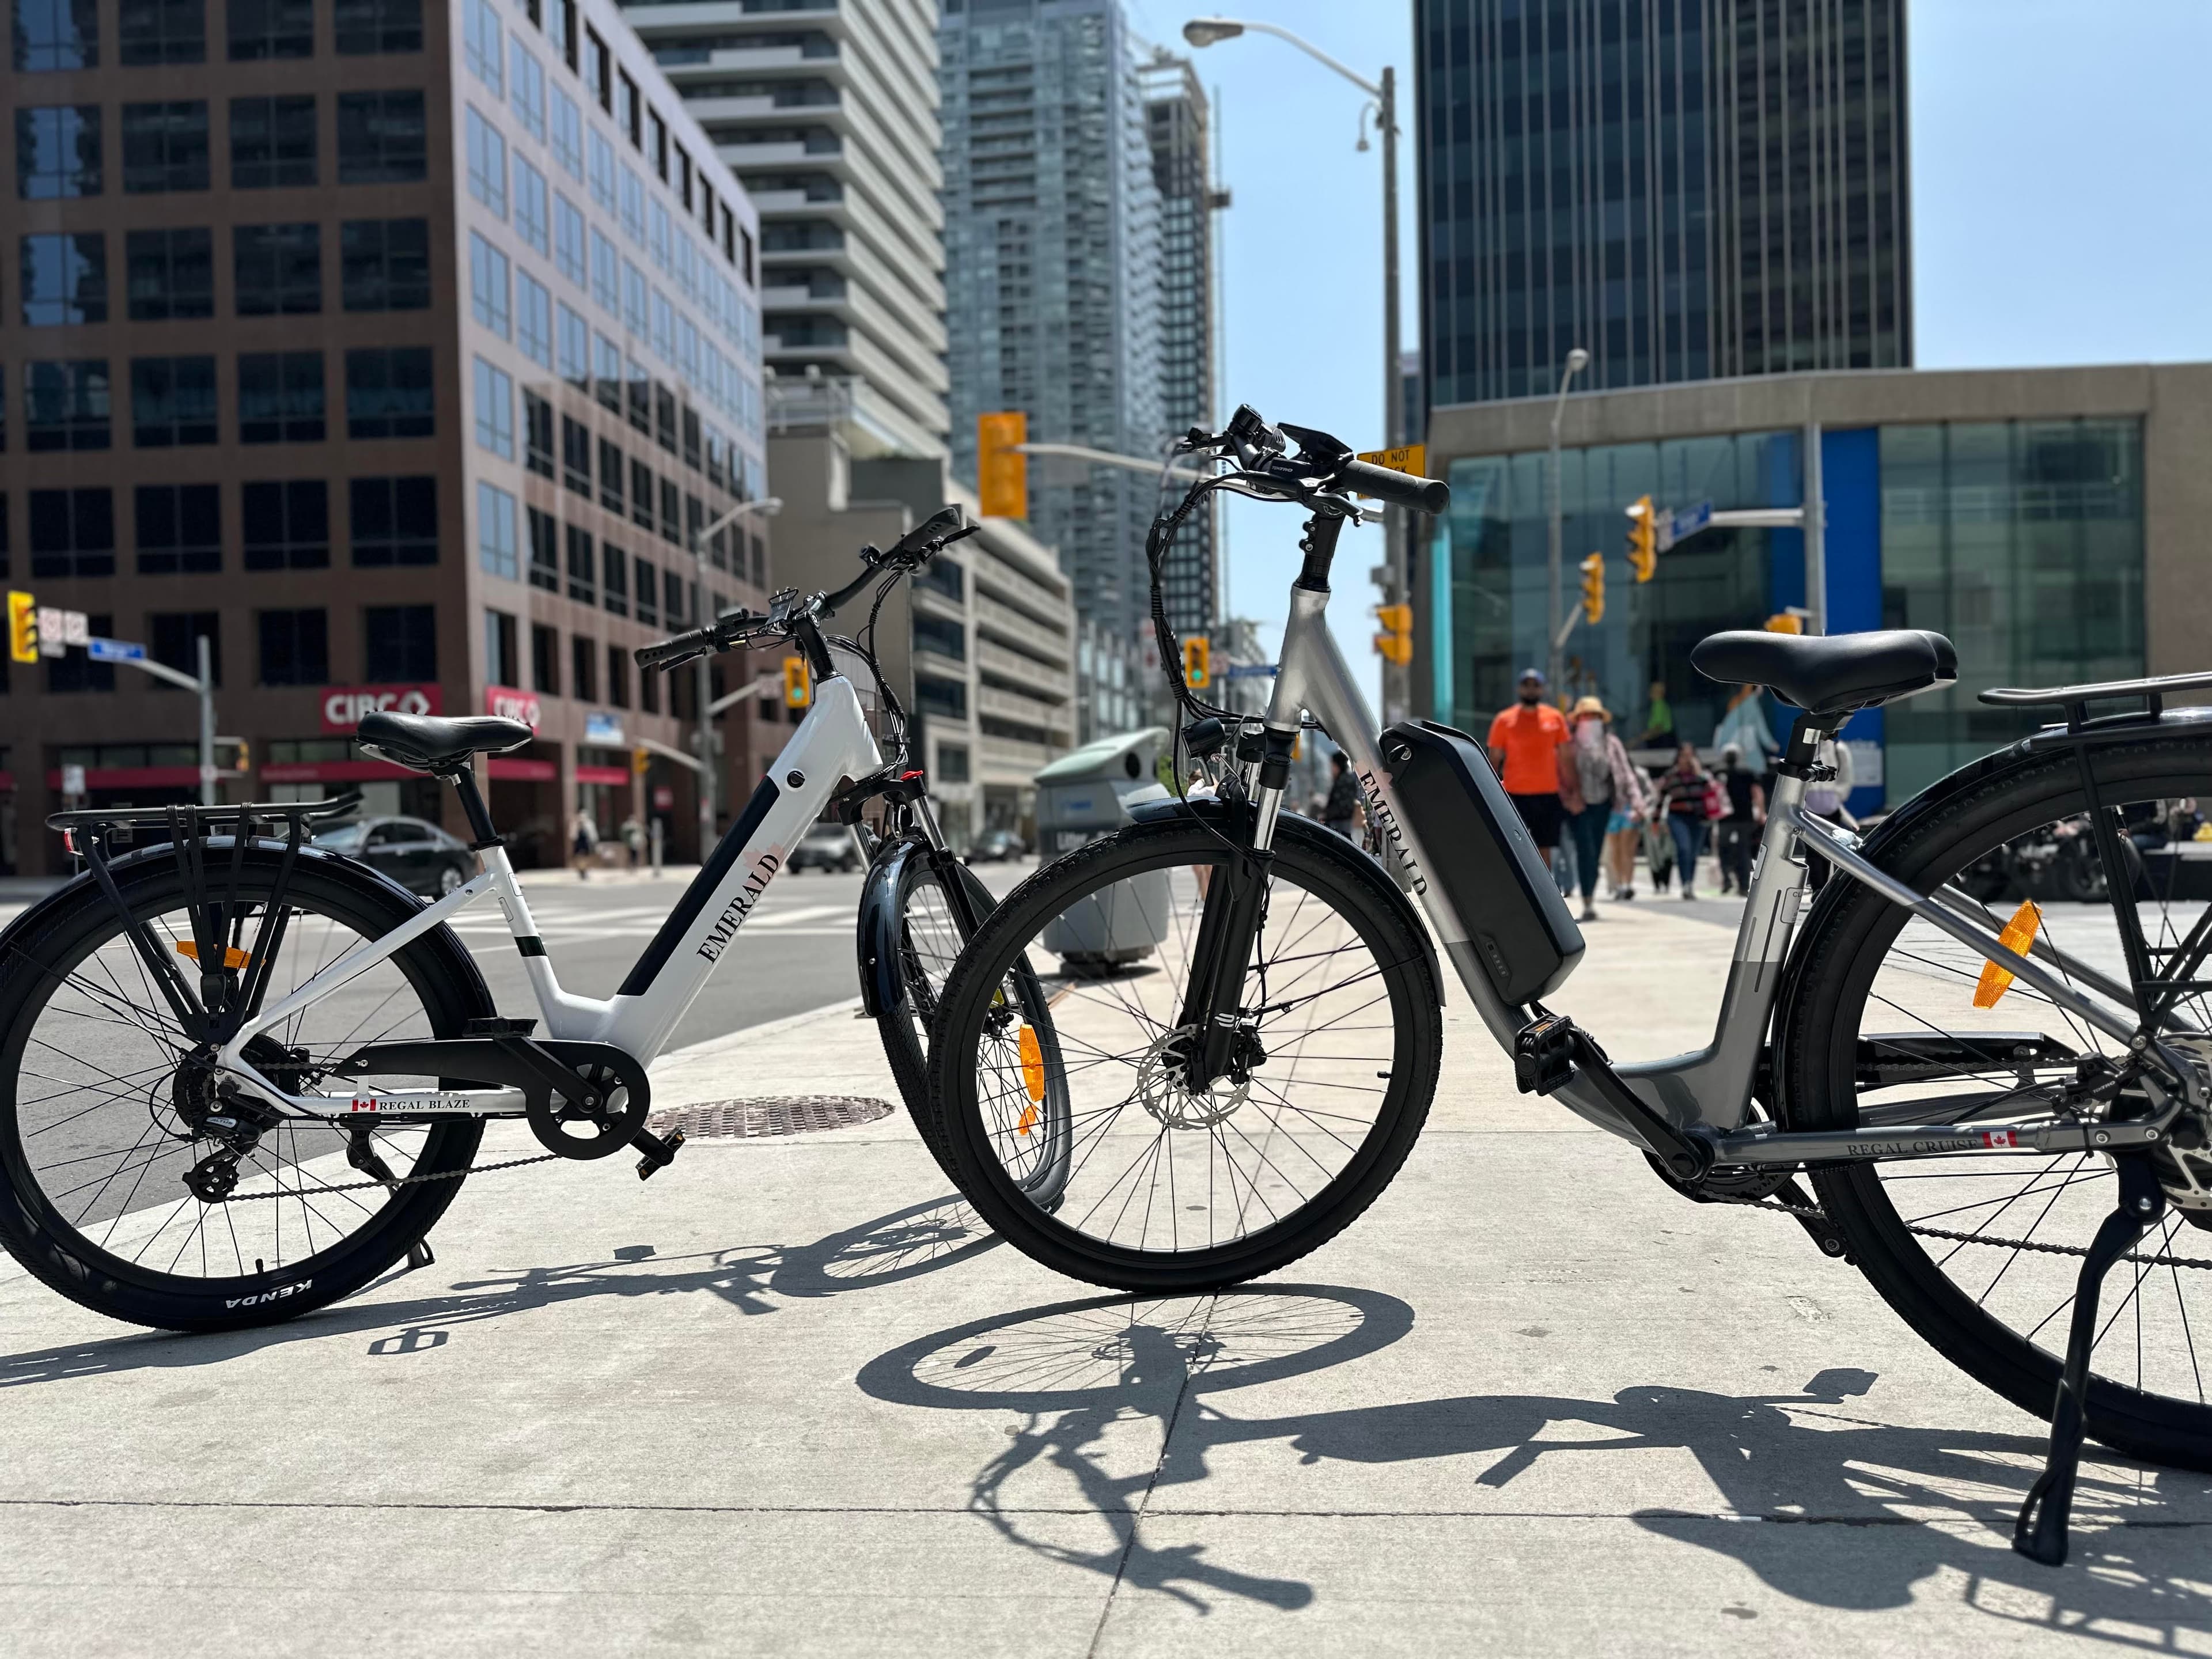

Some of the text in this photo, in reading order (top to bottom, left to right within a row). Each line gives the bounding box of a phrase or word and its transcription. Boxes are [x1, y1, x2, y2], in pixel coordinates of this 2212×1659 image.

[1372, 449, 1410, 465] DO NOT
[1360, 770, 1427, 896] EMERALD
[697, 854, 779, 964] EMERALD
[379, 1100, 470, 1111] REGAL BLAZE
[1847, 1139, 1978, 1156] REGAL CRUISE
[226, 1279, 312, 1308] KENDA
